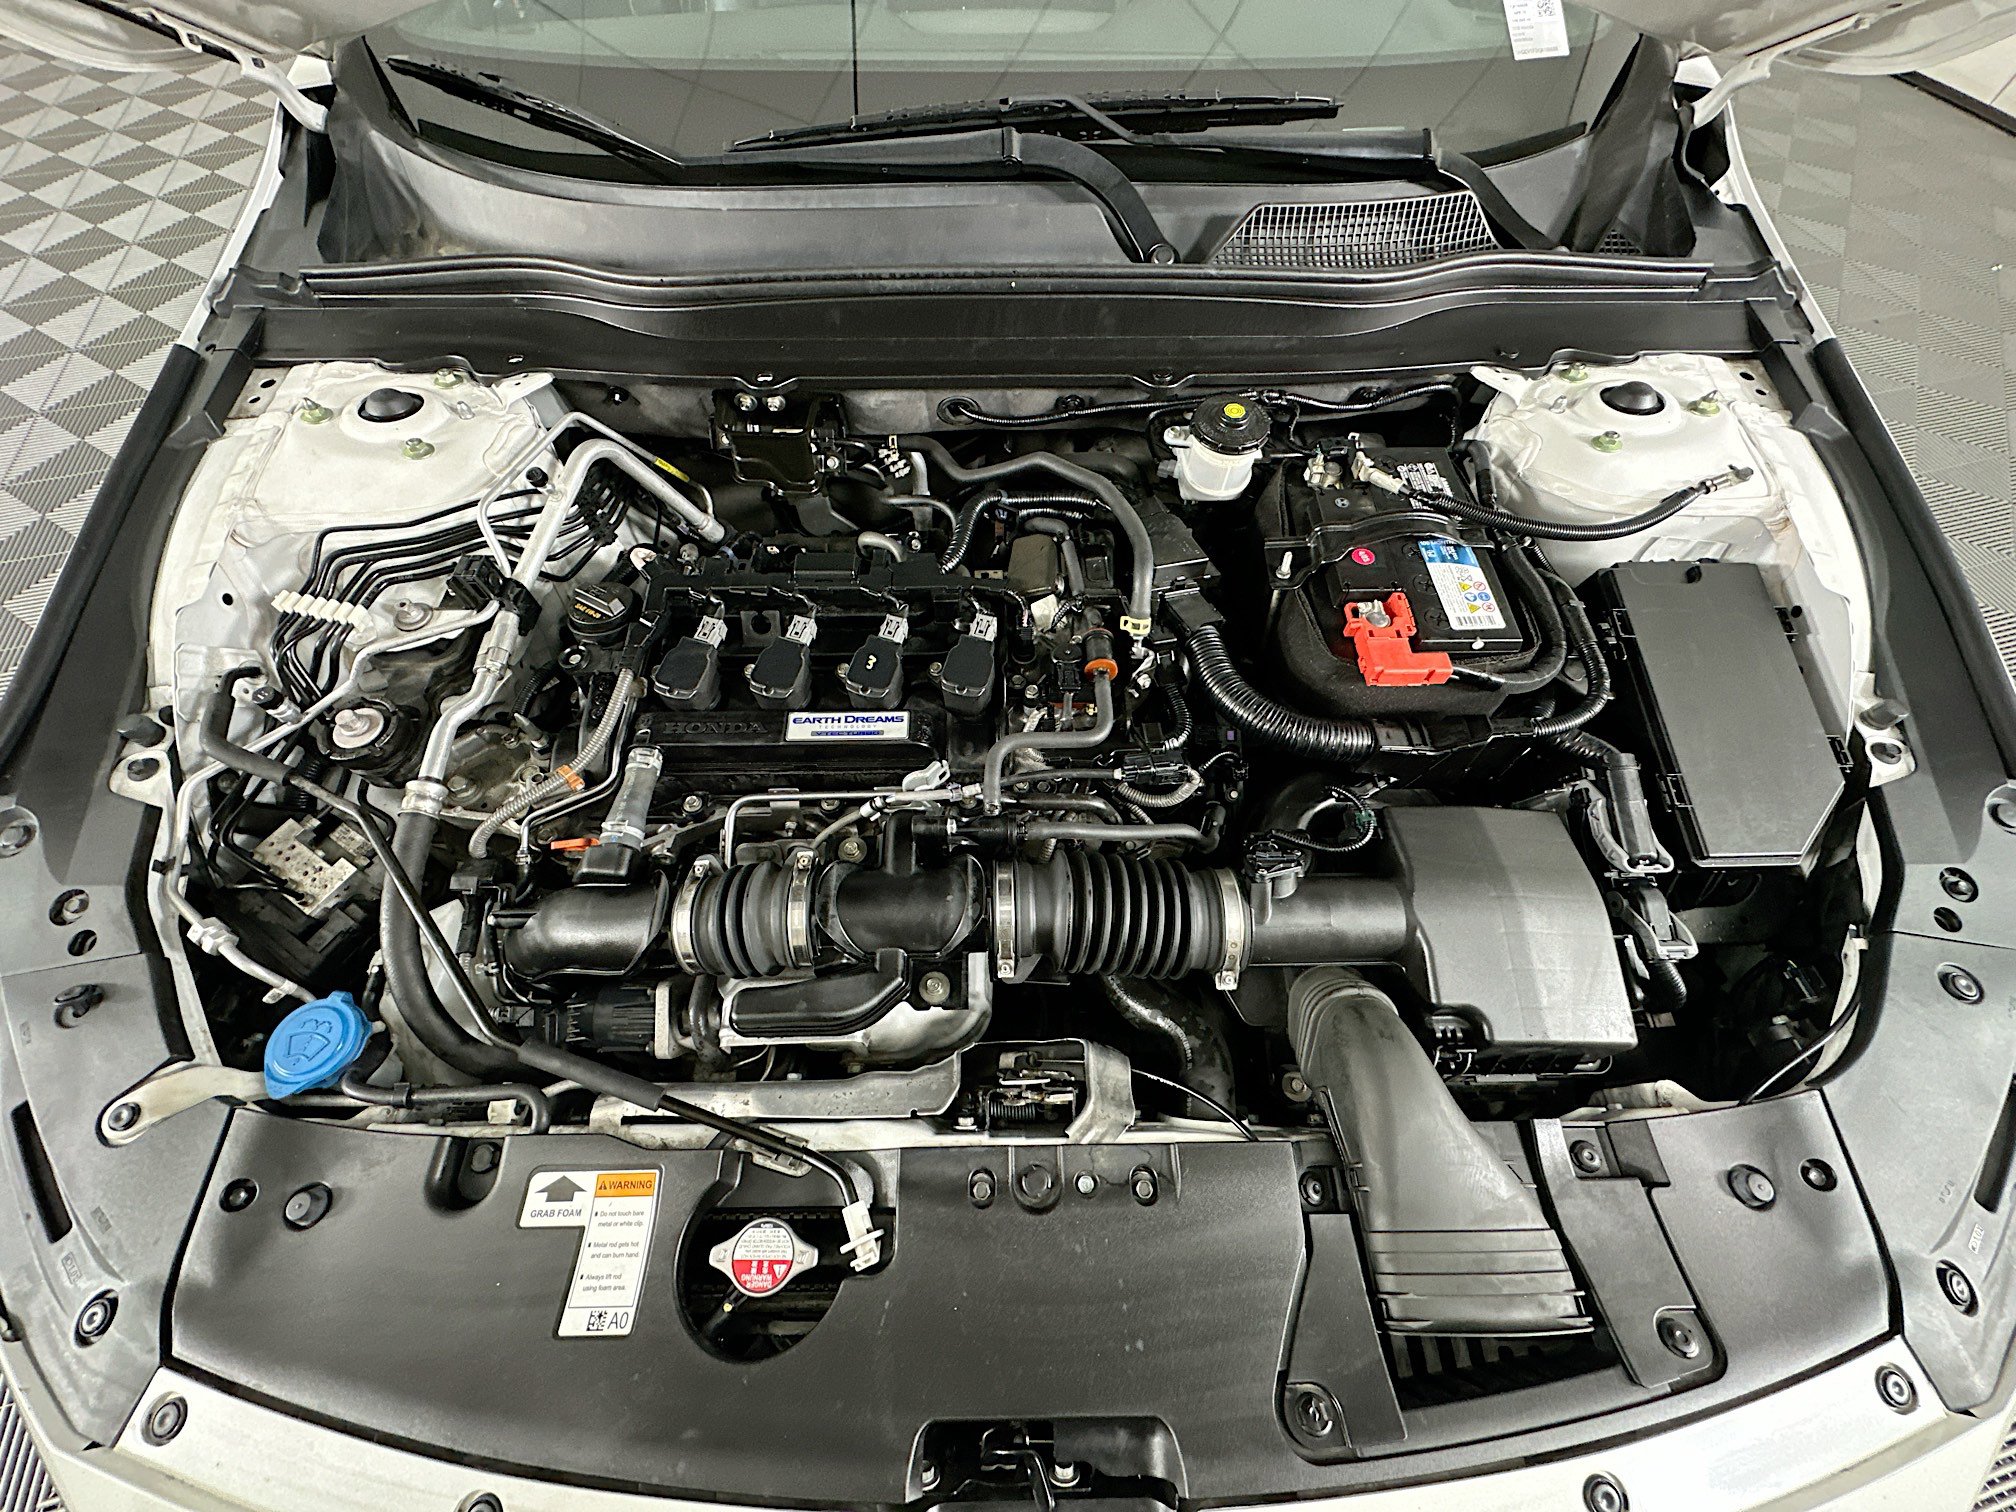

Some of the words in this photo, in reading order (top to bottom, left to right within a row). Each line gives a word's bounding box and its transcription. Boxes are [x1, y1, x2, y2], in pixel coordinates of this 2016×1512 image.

[866, 655, 877, 669] 3
[793, 716, 841, 725] EARTH
[844, 715, 904, 724] DREAMS
[663, 722, 768, 734] HONDA
[609, 1180, 653, 1190] WARNING
[530, 1209, 555, 1218] GRAB
[556, 1208, 582, 1217] FOAM
[607, 1311, 629, 1329] A0
